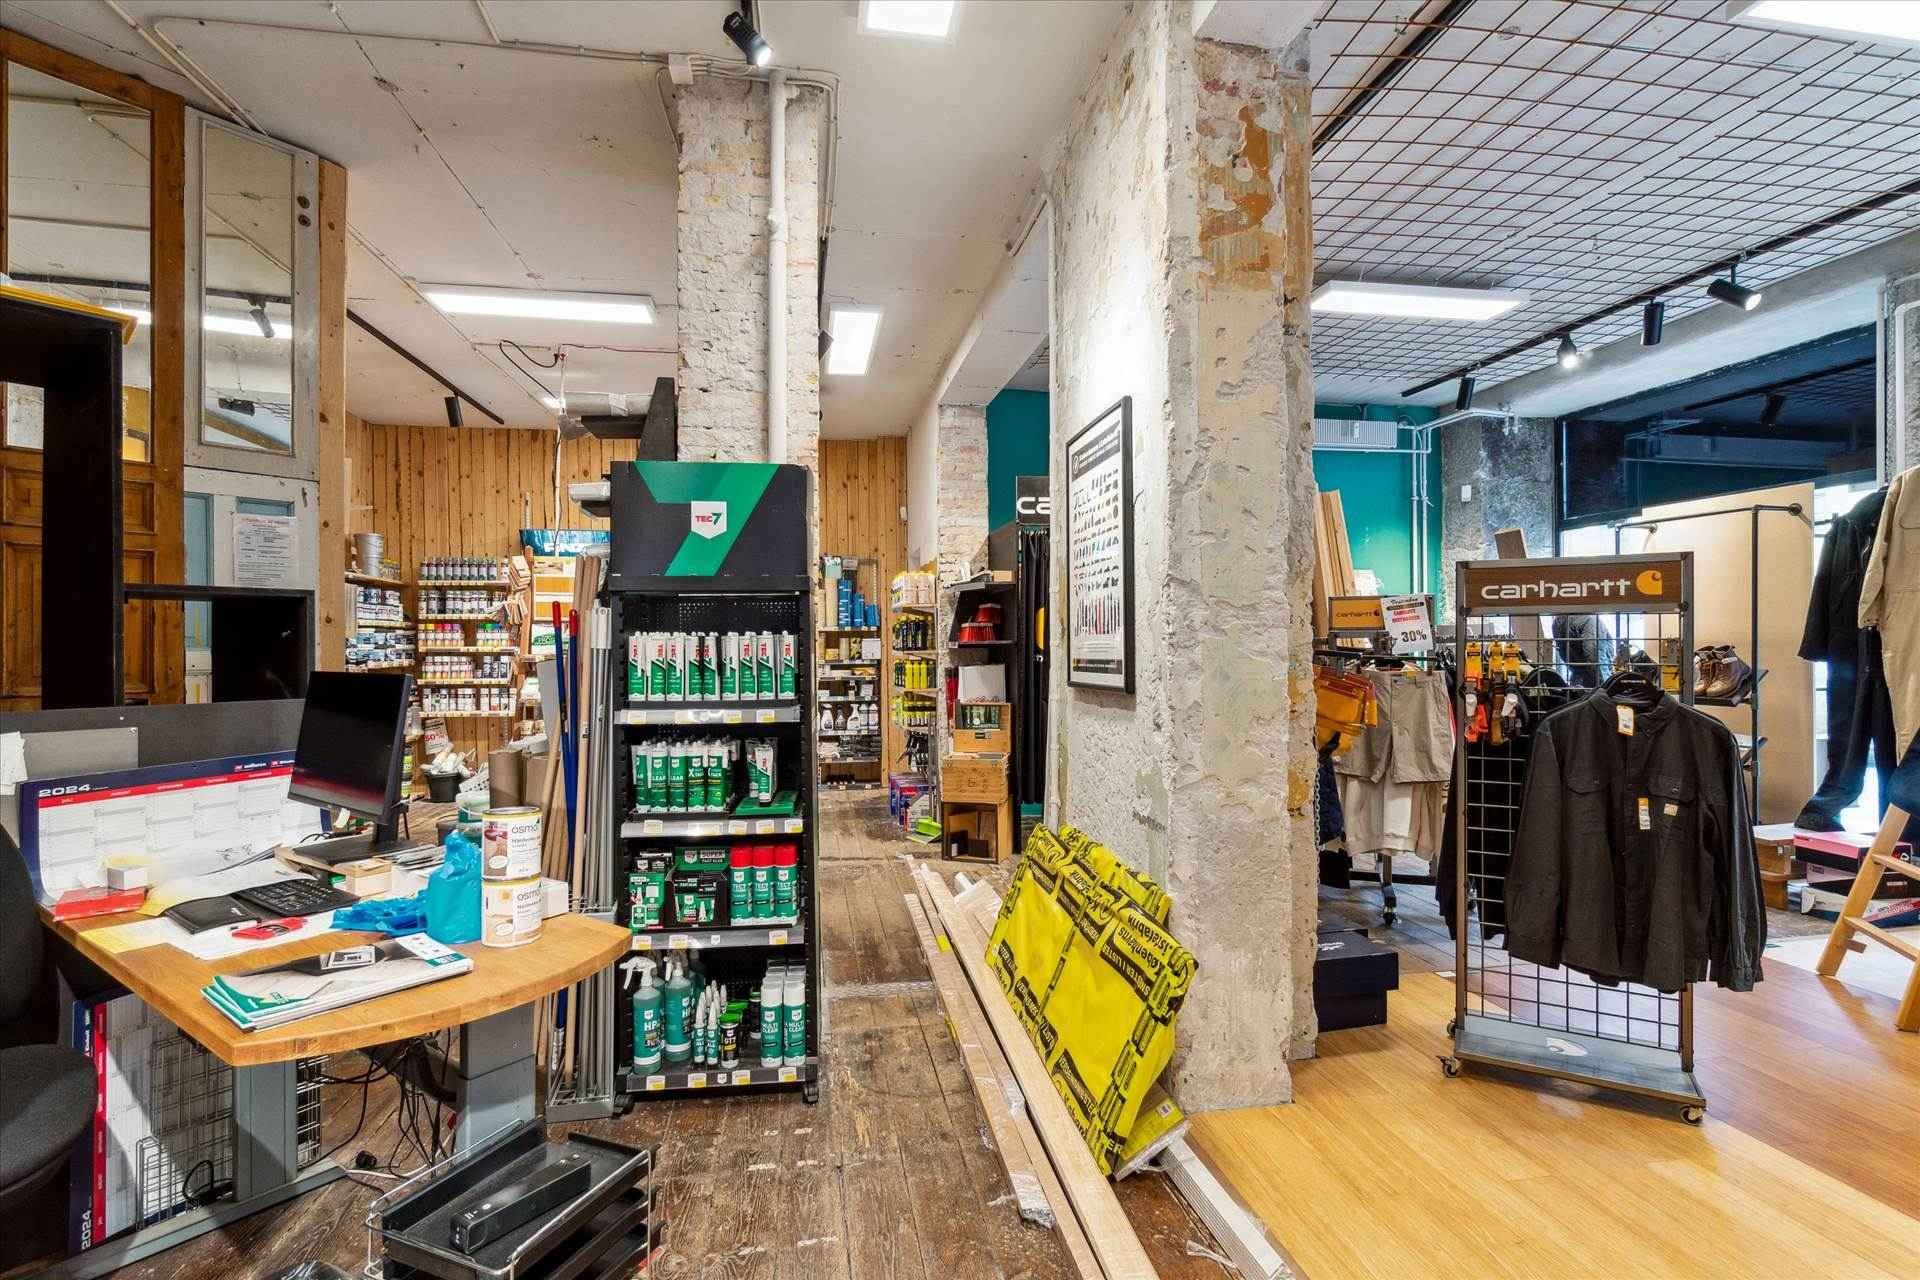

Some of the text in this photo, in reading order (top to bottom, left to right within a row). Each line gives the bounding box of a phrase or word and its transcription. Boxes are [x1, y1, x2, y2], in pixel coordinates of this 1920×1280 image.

[695, 512, 722, 526] TEC7
[1480, 578, 1631, 600] carhartt
[1401, 629, 1427, 642] 30%
[38, 784, 92, 798] 2024
[1126, 914, 1174, 956] istefabrik
[81, 1209, 92, 1250] 2024
